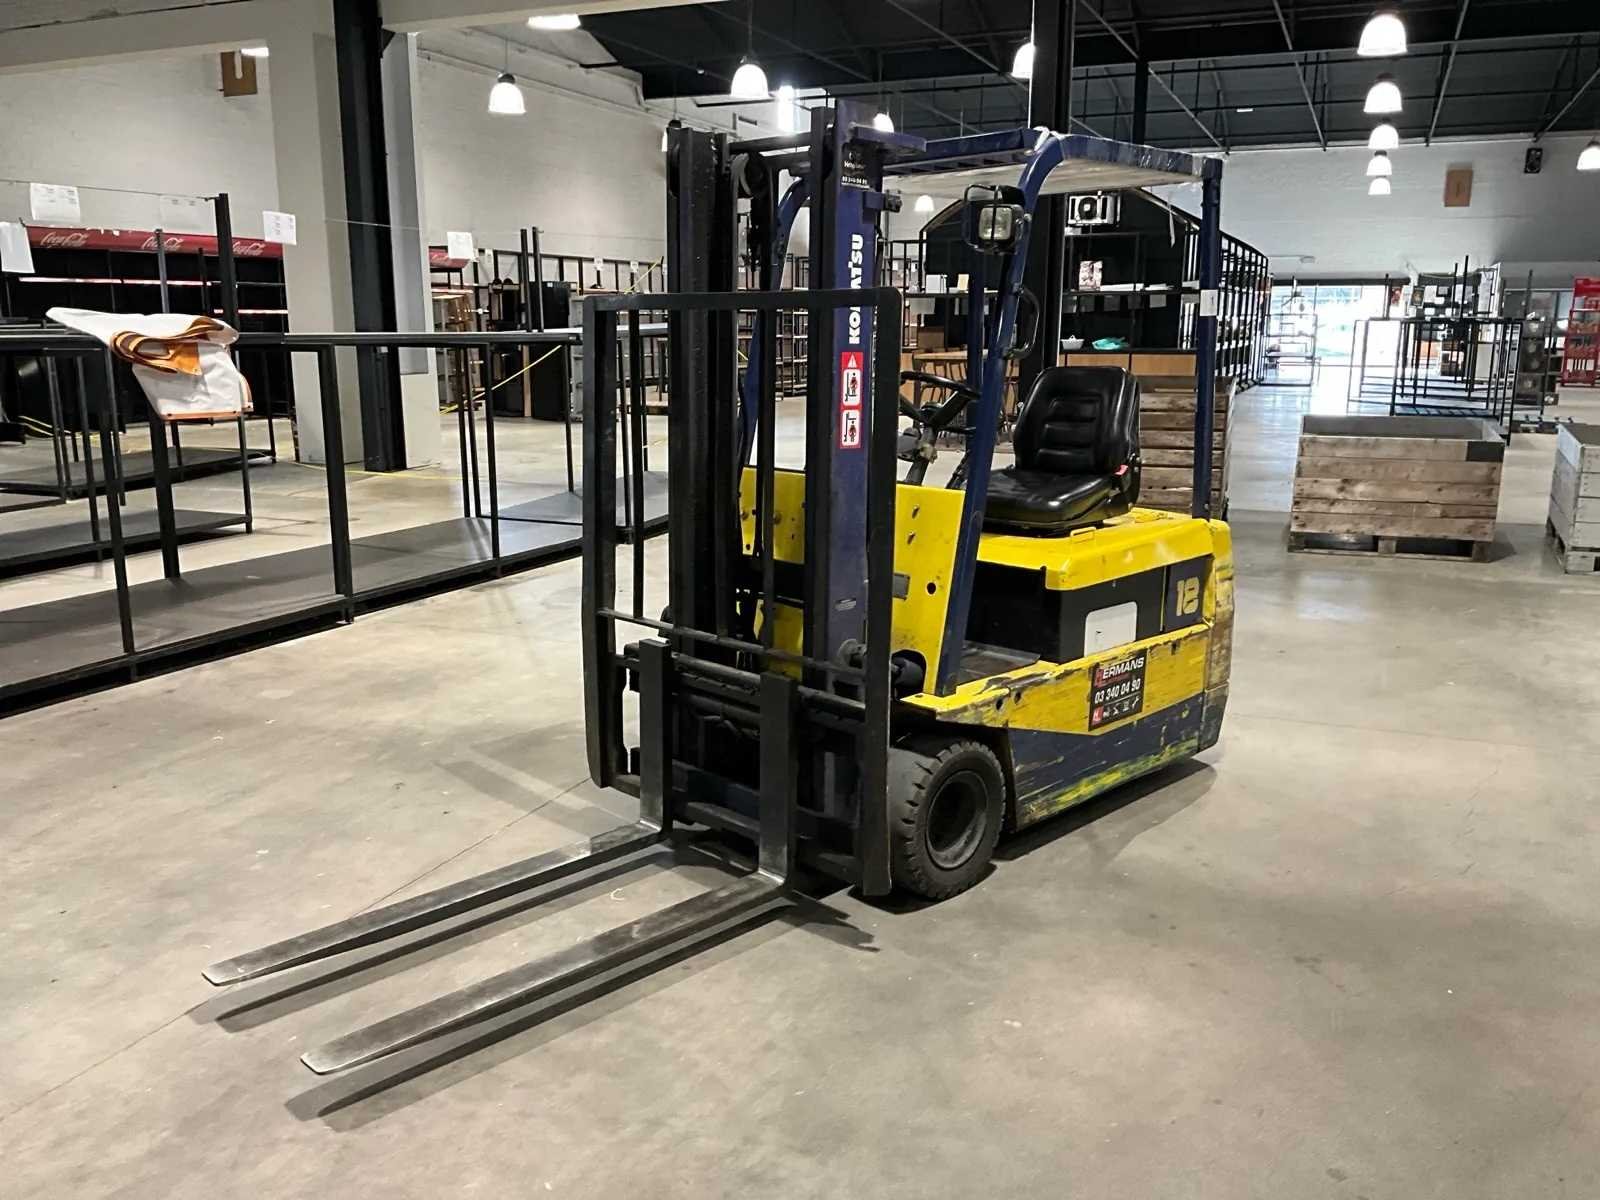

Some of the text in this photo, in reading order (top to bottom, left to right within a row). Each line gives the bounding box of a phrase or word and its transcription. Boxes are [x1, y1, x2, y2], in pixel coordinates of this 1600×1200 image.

[848, 233, 863, 344] KOATSU
[1094, 678, 1141, 704] 03 340 04 90
